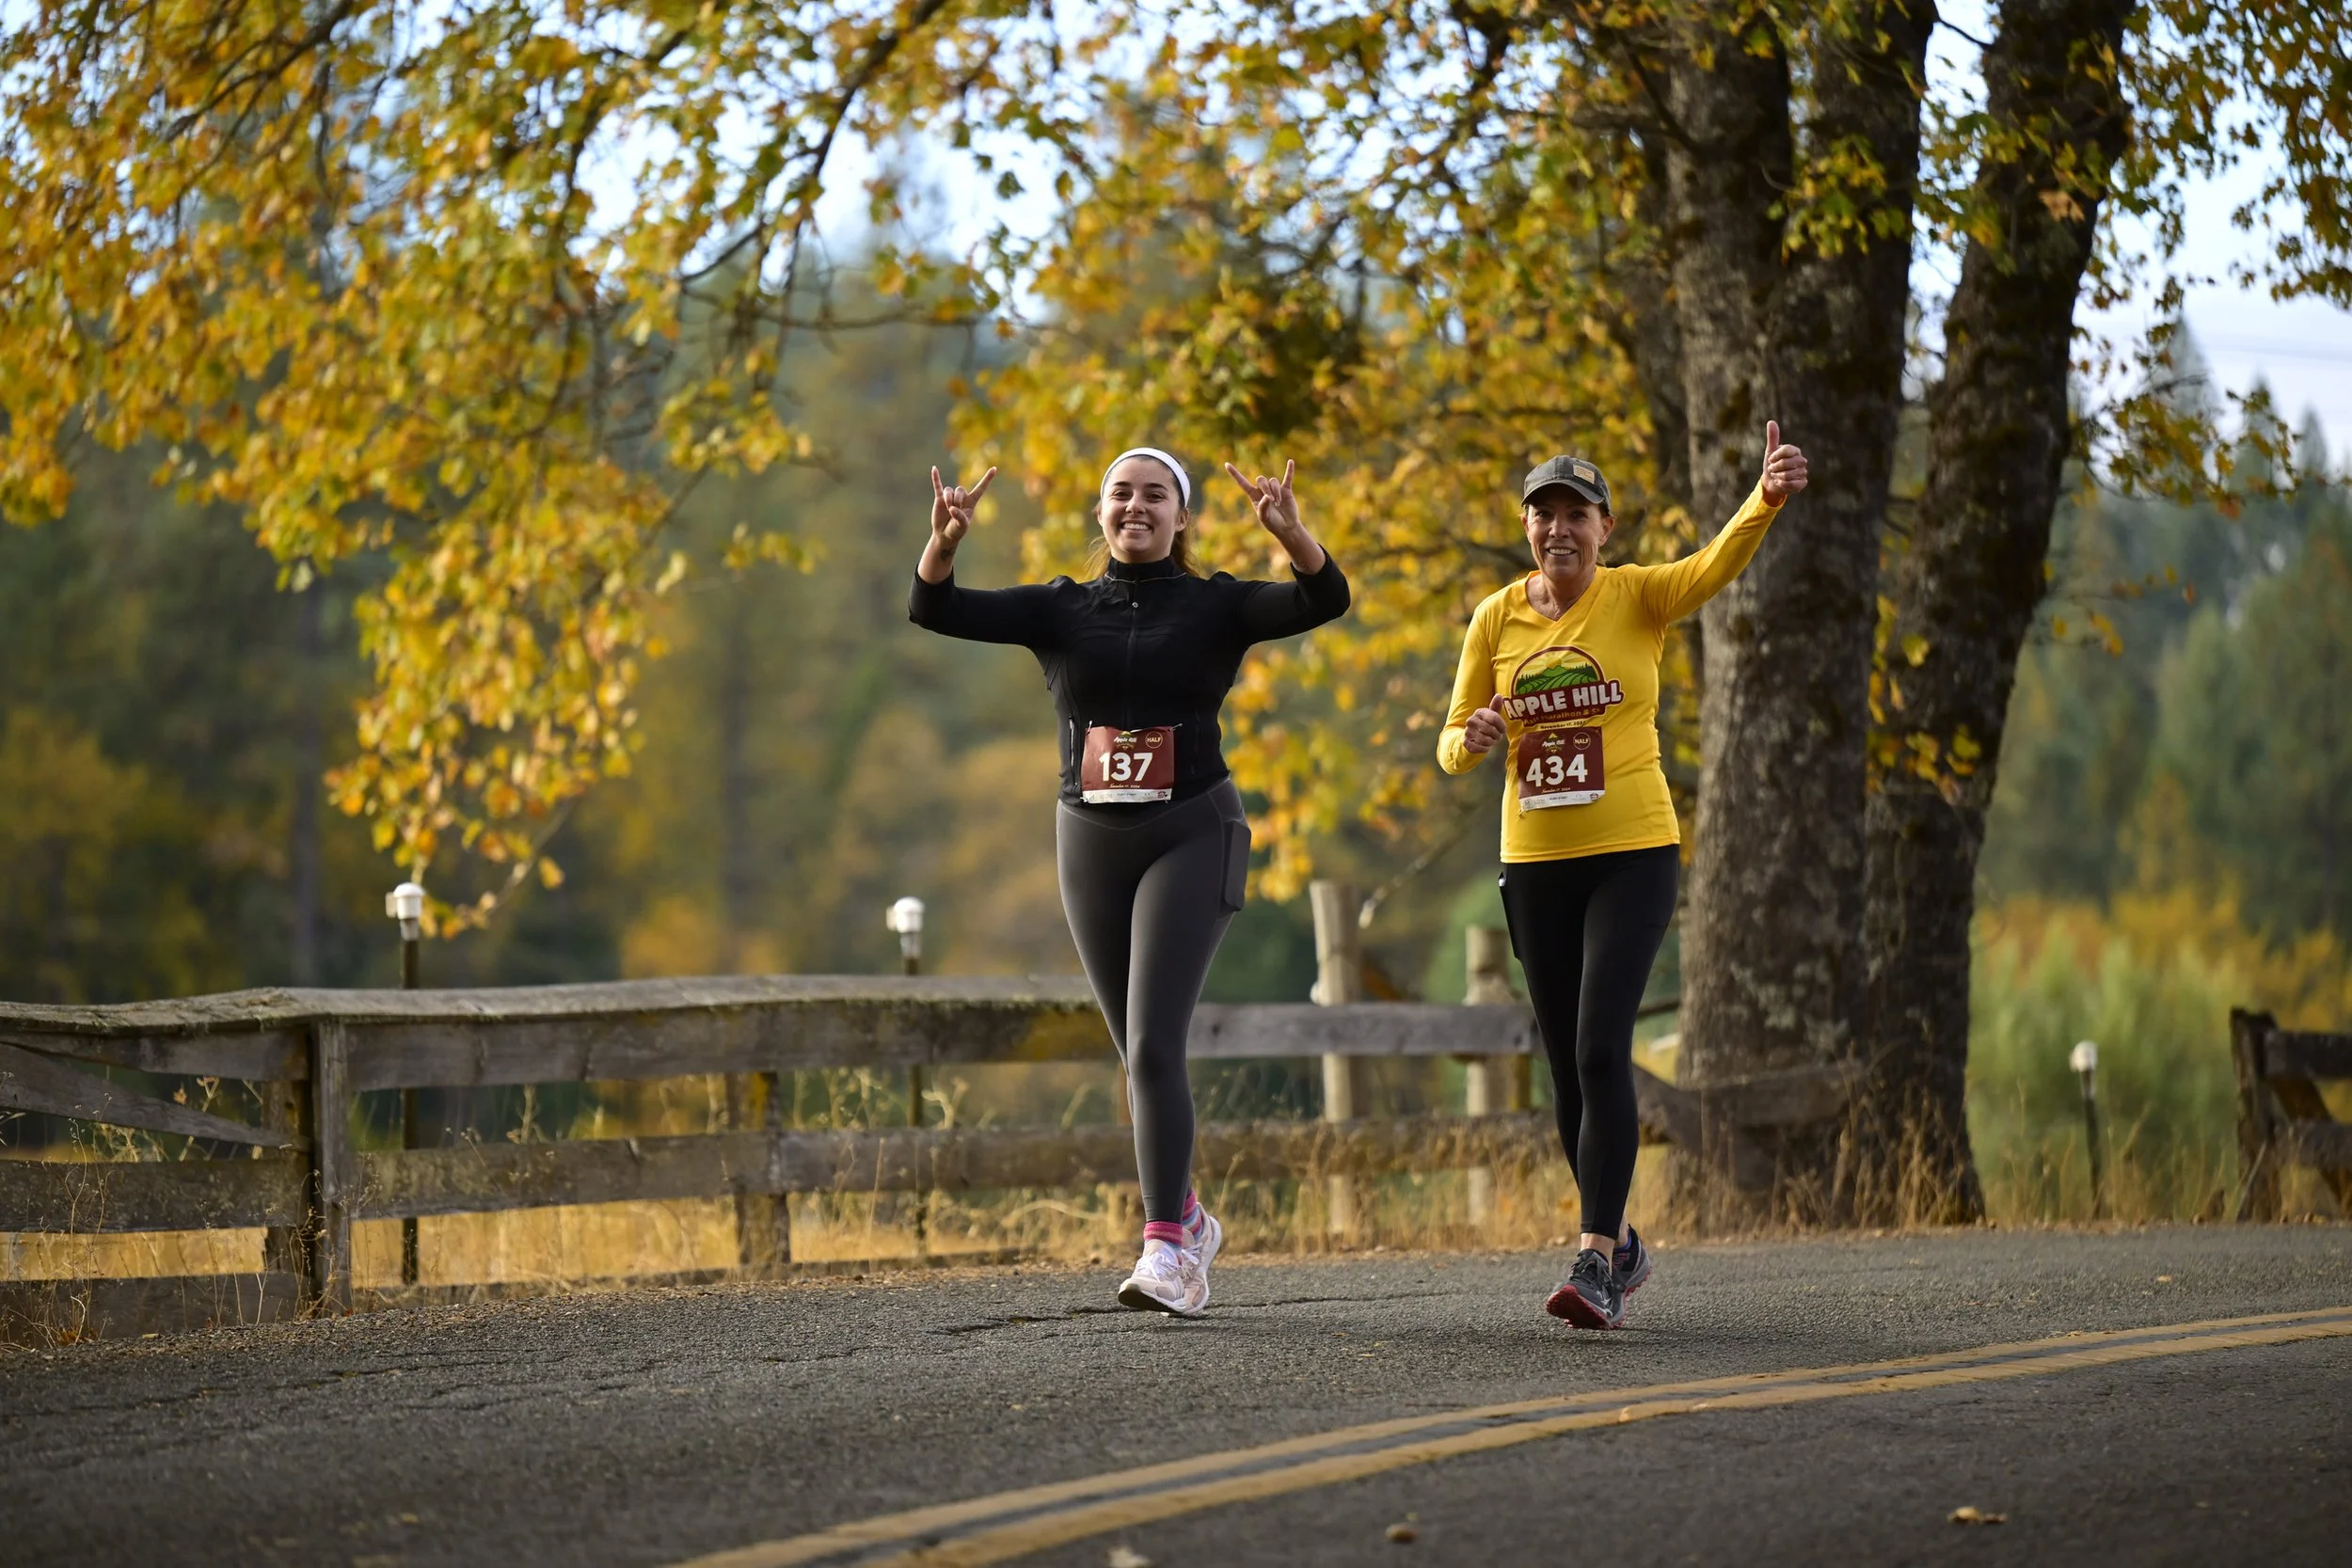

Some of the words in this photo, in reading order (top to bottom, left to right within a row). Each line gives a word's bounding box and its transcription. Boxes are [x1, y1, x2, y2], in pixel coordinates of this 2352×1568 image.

[1504, 690, 1567, 719] APPLE
[1572, 682, 1622, 707] HILL
[1099, 752, 1153, 782] 137
[1526, 753, 1588, 787] 434
